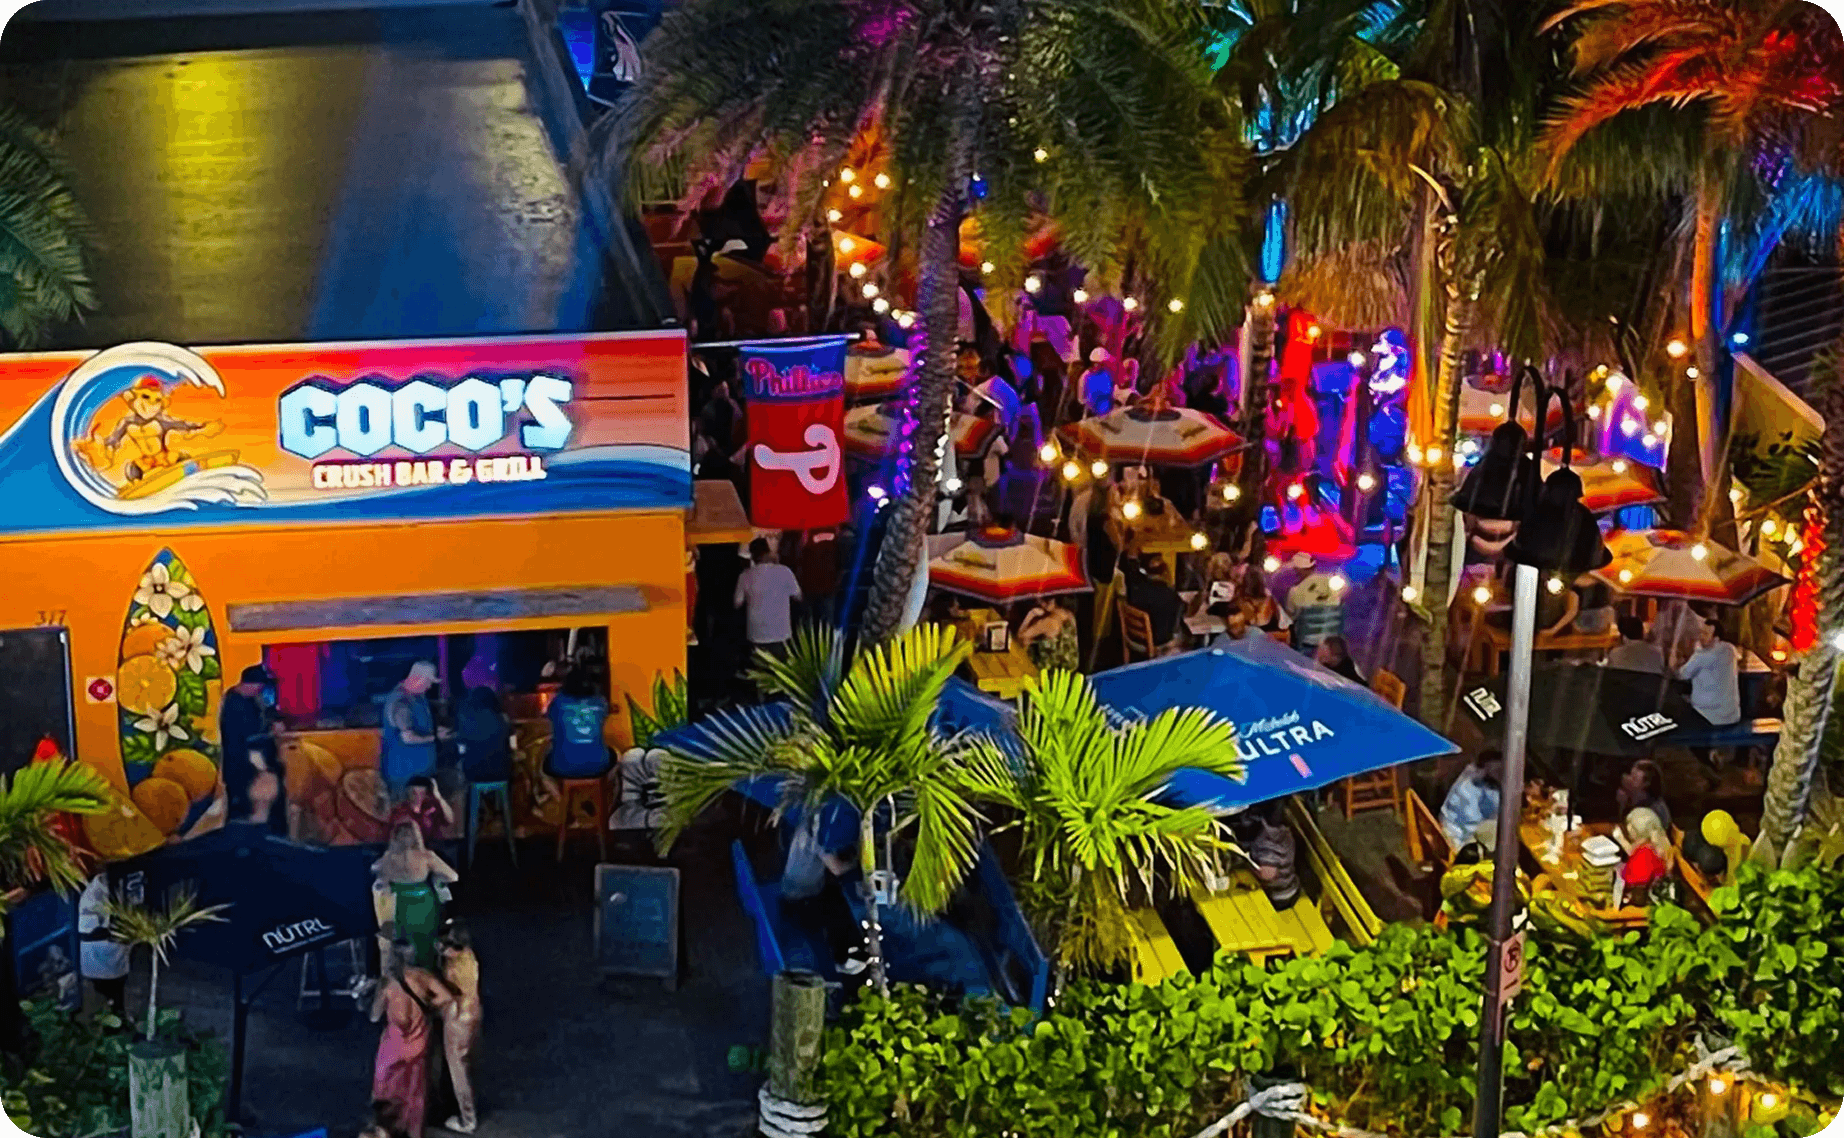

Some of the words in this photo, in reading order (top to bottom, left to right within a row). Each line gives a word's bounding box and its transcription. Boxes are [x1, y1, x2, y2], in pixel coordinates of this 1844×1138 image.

[280, 374, 573, 460] COCO'S
[313, 464, 392, 489] CRUSH
[395, 460, 446, 486] BAR
[449, 458, 473, 484] &
[475, 456, 547, 483] GRILL
[1236, 720, 1335, 761] ULTRA
